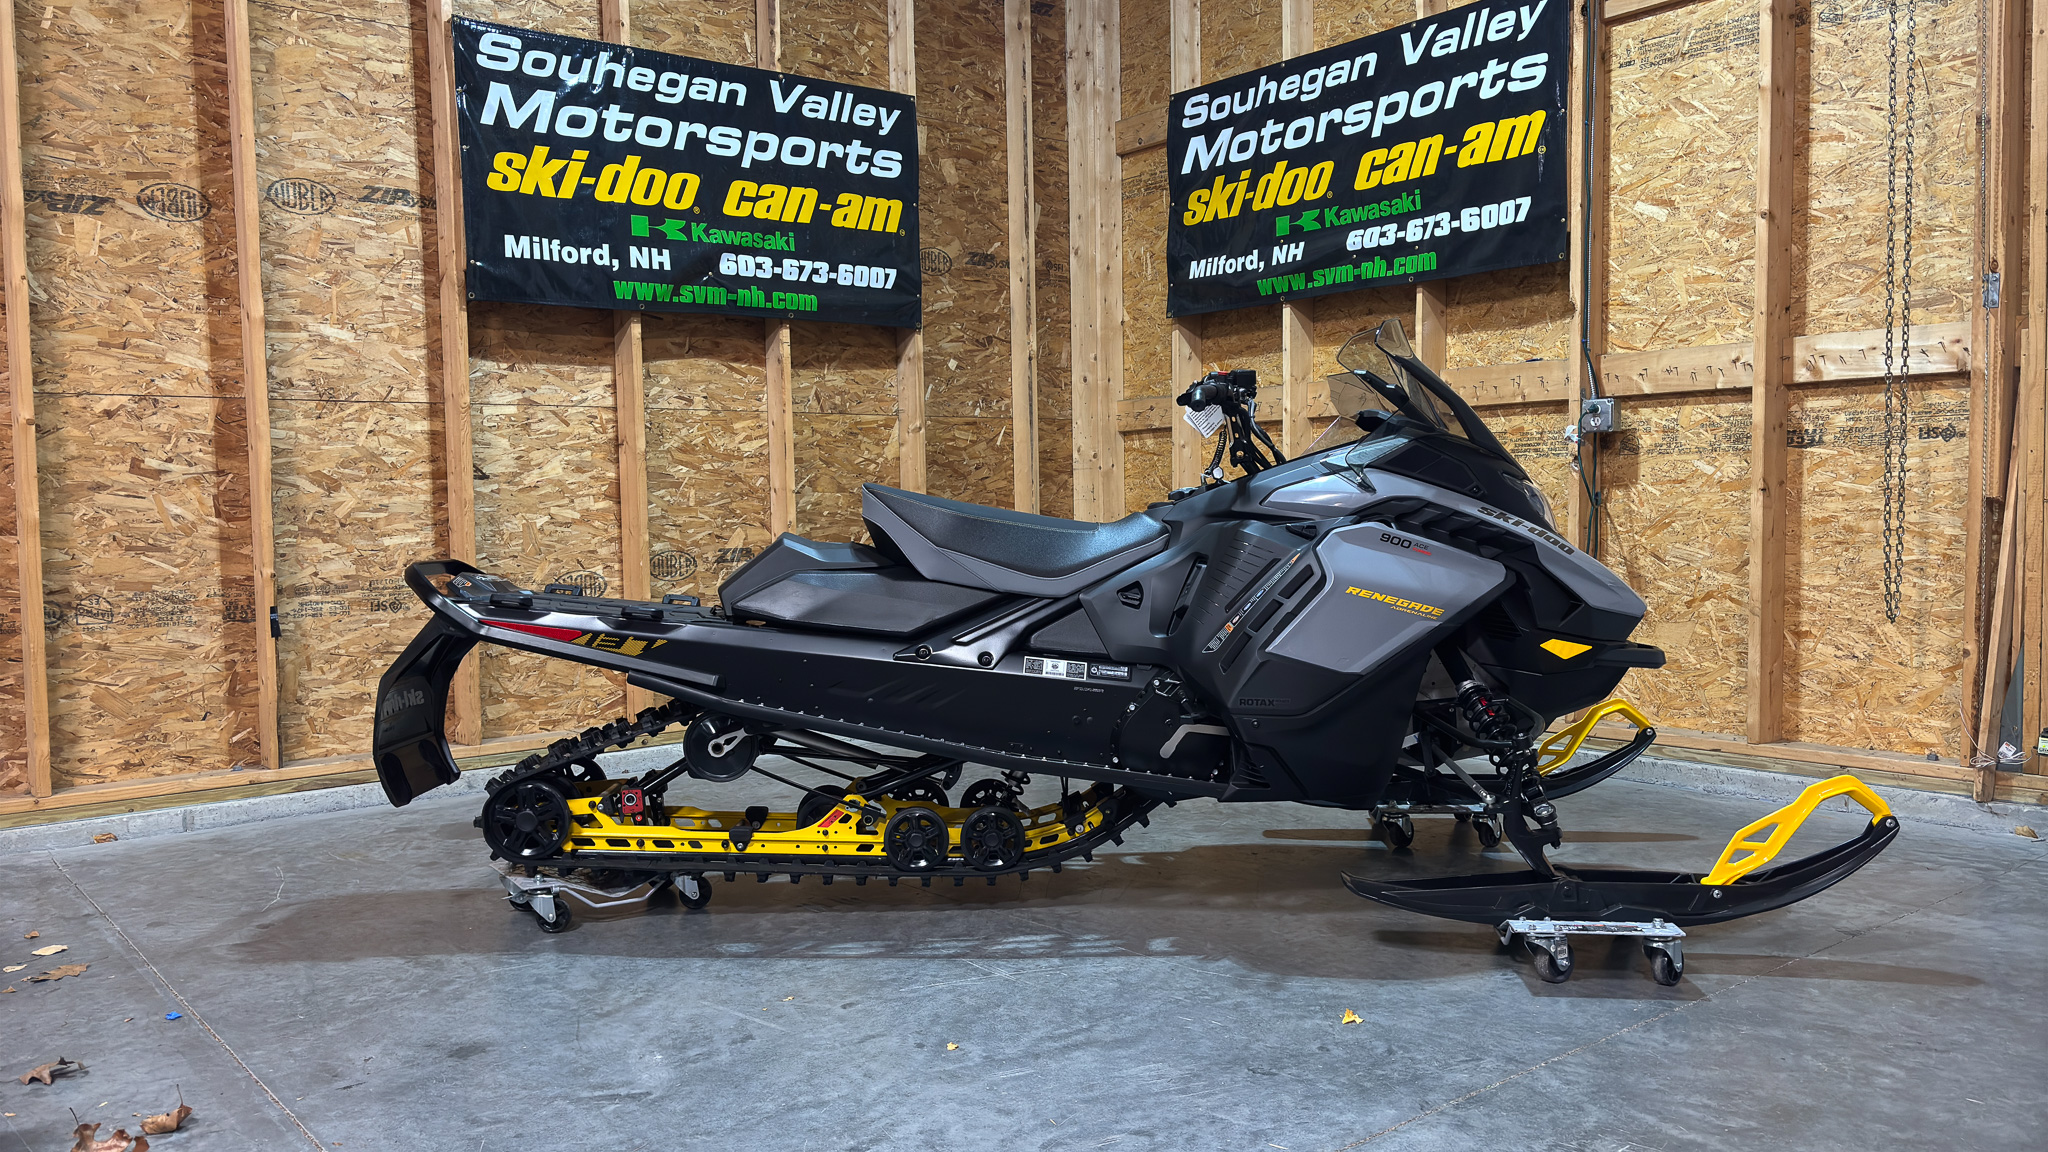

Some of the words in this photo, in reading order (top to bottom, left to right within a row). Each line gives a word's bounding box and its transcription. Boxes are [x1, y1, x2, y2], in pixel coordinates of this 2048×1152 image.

[1182, 52, 1378, 129] Souhegan
[1400, 0, 1548, 67] Valley
[476, 32, 746, 107] Souhegan
[769, 80, 901, 136] Valley
[480, 81, 903, 179] Motorsports
[1181, 52, 1550, 175] Motorsports
[1183, 159, 1334, 227] ski-doo
[1353, 109, 1547, 191] can-am
[269, 181, 333, 212] HUBER
[486, 145, 701, 211] ski-doo
[722, 180, 904, 234] can-am
[1325, 189, 1421, 228] Kawasaki
[691, 222, 795, 251] Kawasaki
[1346, 196, 1532, 251] 603-673-6007
[504, 234, 620, 272] Milford,
[629, 246, 671, 270] NH
[719, 252, 897, 290] 603-673-6007
[920, 250, 950, 273] HUBER
[1189, 248, 1264, 279] Milford,
[1272, 242, 1305, 264] NH
[1257, 249, 1437, 296] www.svm-nh.com
[613, 279, 818, 312] www.svm-nh.com
[1380, 532, 1412, 549] 900
[1413, 542, 1430, 550] ACE
[1476, 506, 1576, 556] ski-doo
[651, 553, 693, 578] HUBER
[370, 600, 388, 612] SFI
[1345, 585, 1445, 616] RENEGADE
[1390, 605, 1438, 620] ADRENALINE
[1239, 698, 1275, 707] ROTAX
